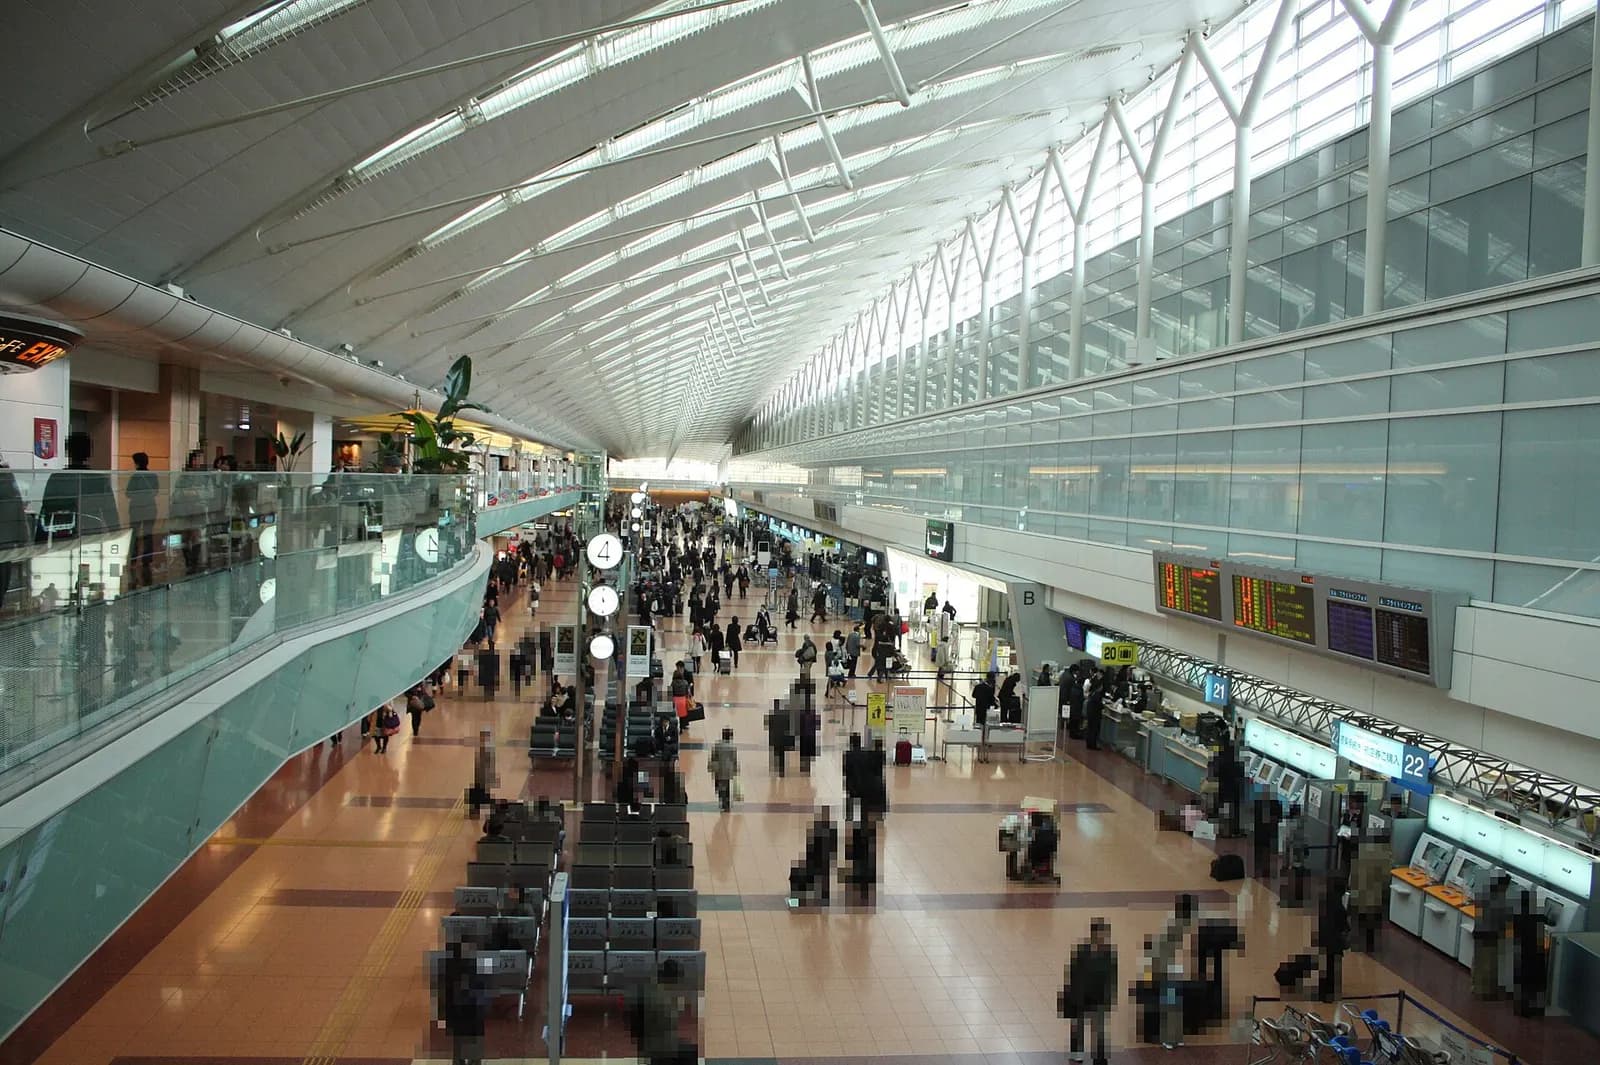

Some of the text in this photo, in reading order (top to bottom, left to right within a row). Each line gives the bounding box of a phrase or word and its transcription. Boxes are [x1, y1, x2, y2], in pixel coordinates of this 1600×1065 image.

[597, 541, 611, 561] 4
[1024, 591, 1035, 606] B
[1104, 647, 1117, 660] 20
[1213, 683, 1225, 699] 21
[1404, 754, 1425, 777] 22
